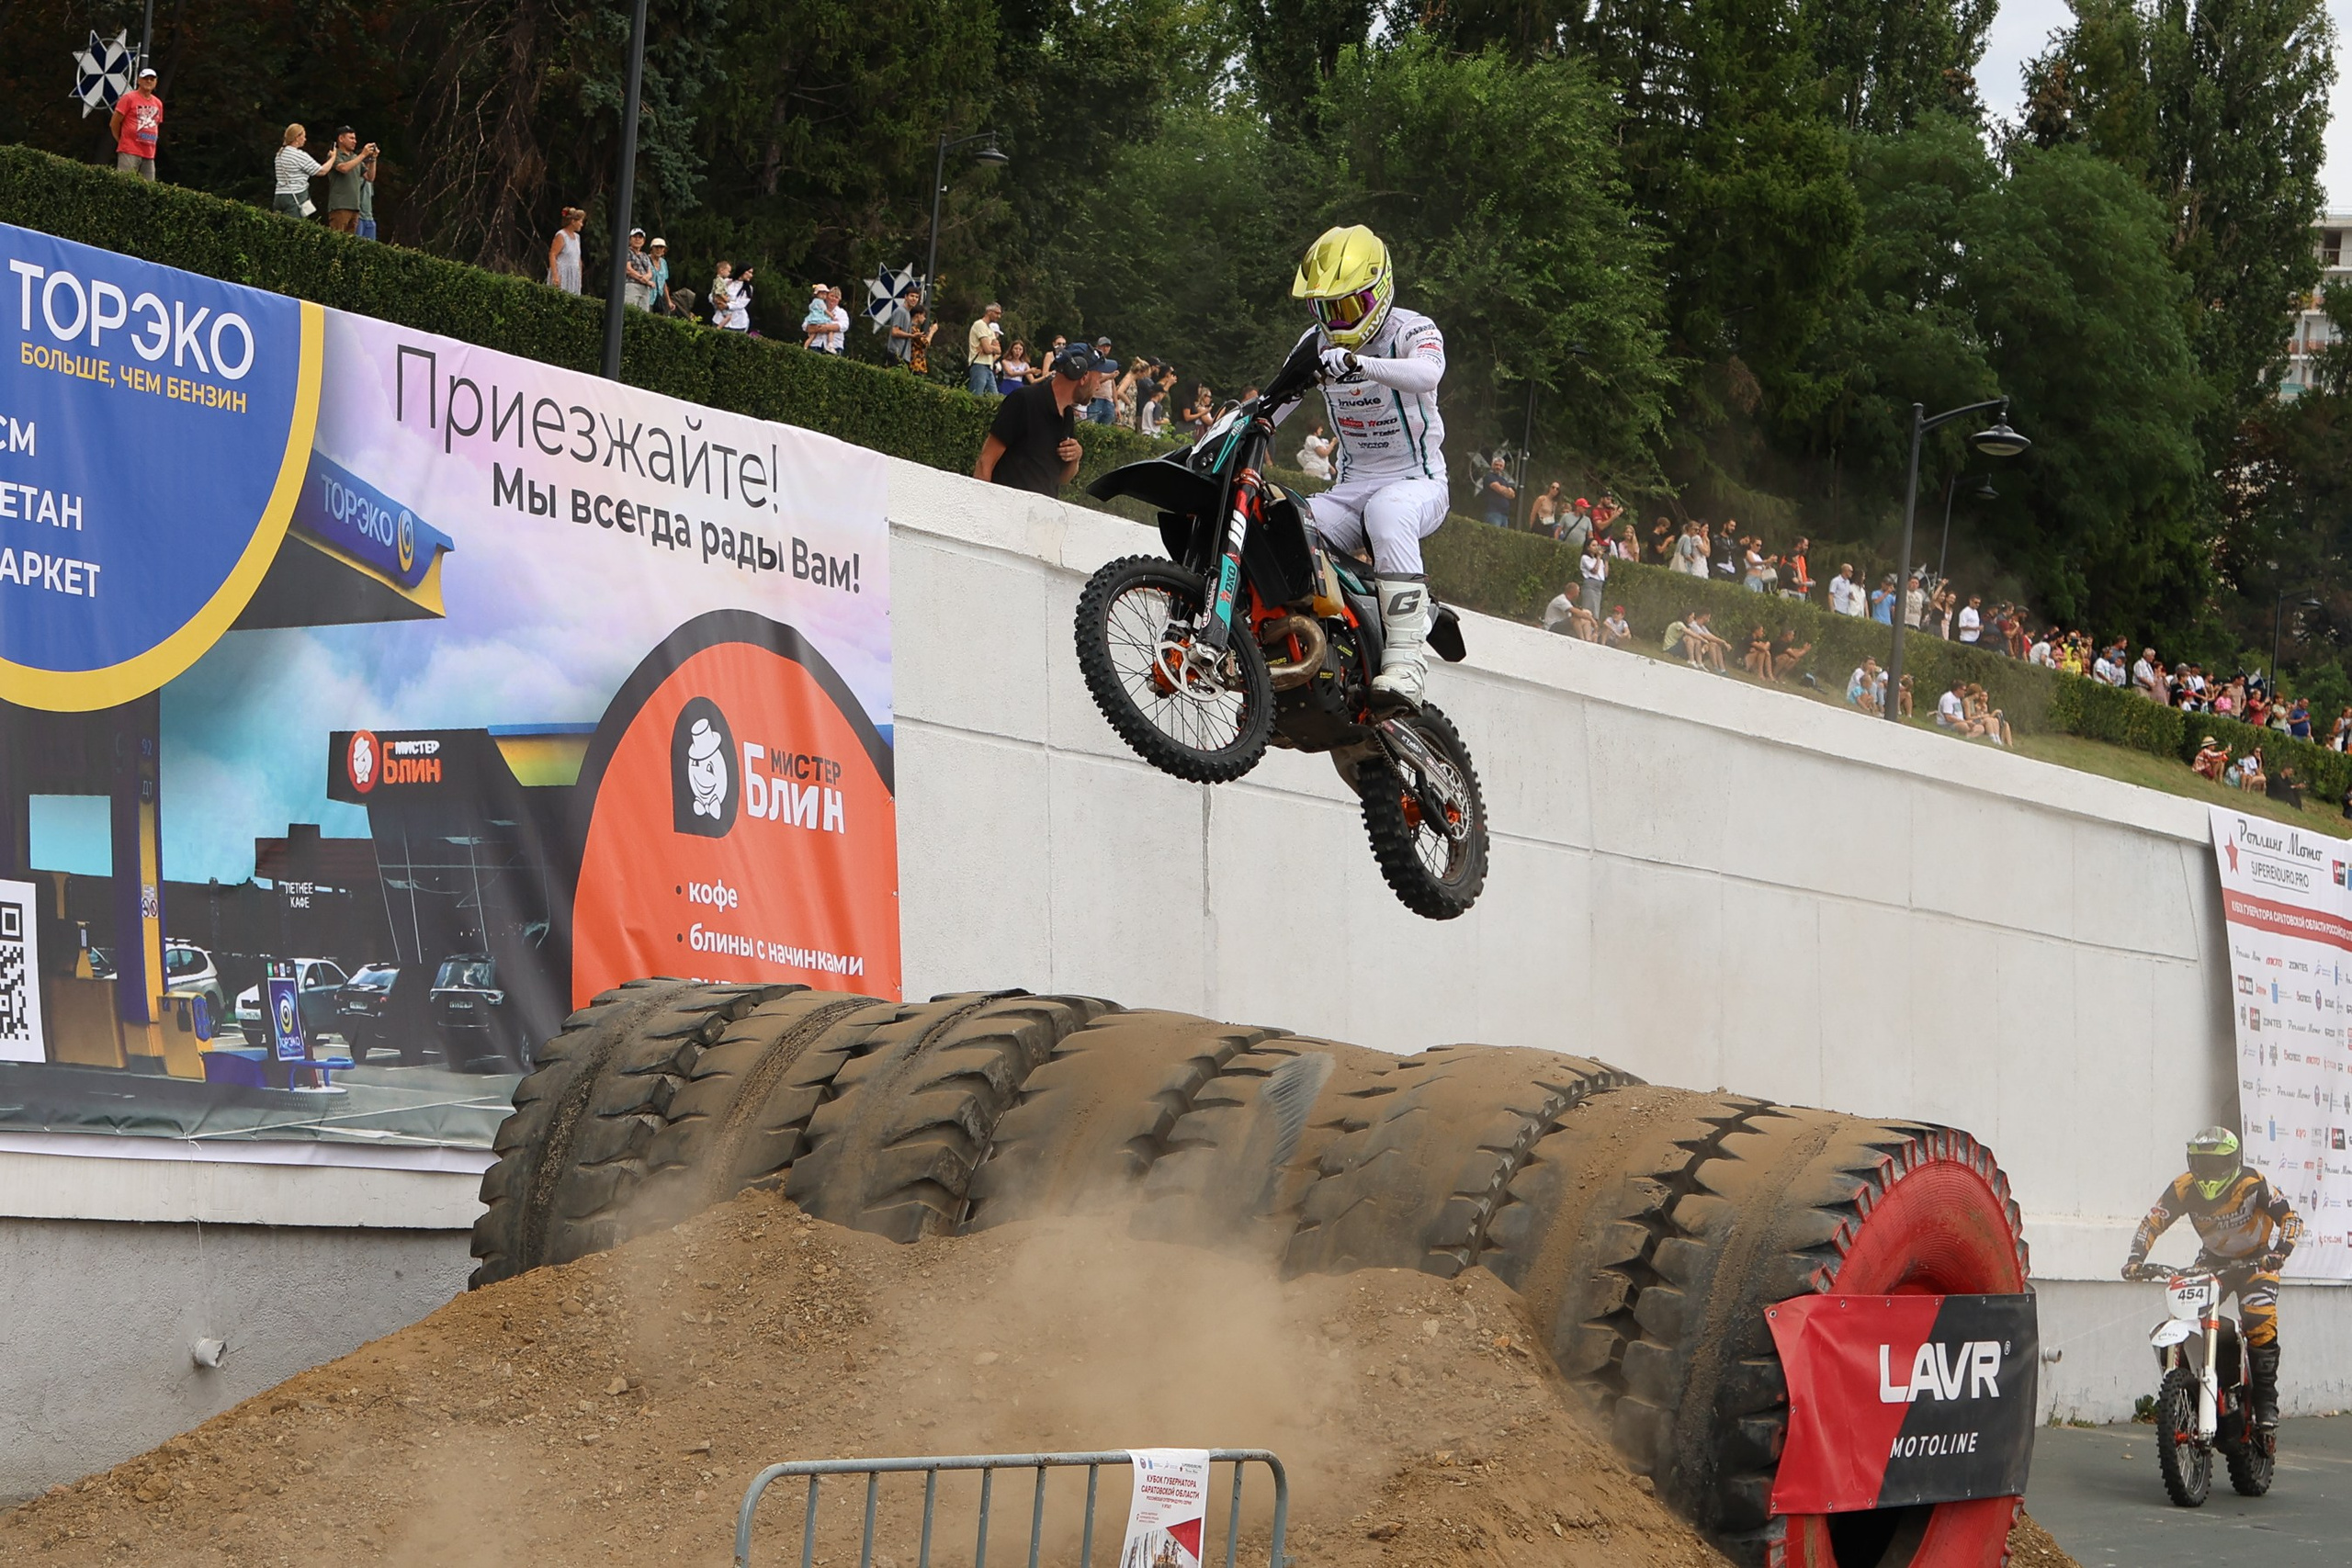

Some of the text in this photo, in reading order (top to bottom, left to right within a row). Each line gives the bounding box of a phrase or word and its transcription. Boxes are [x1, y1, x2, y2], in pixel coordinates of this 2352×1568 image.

[9, 258, 254, 380] ТОРЭКО
[20, 342, 247, 413] БОЛЬШЕ, ЧЕМ БЕНЗИН
[1338, 397, 1381, 407] invoke
[396, 344, 779, 513] Приезжайте!
[0, 480, 83, 531] ЕТАН
[321, 473, 394, 547] ТОРЭКО
[492, 462, 860, 595] Мы всегда рады Вам!
[0, 547, 101, 598] АРКЕТ
[394, 739, 440, 755] МИСТЕР
[770, 748, 842, 785] МИСТЕР
[285, 882, 313, 896] ЛЕТНЕЕ
[289, 897, 310, 908] КАФЕ
[688, 878, 739, 913] кофе
[689, 922, 865, 976] блины с начинками
[2177, 1288, 2204, 1301] 454
[1879, 1340, 2001, 1404] LAVR
[1889, 1431, 1979, 1459] MOTOLINE
